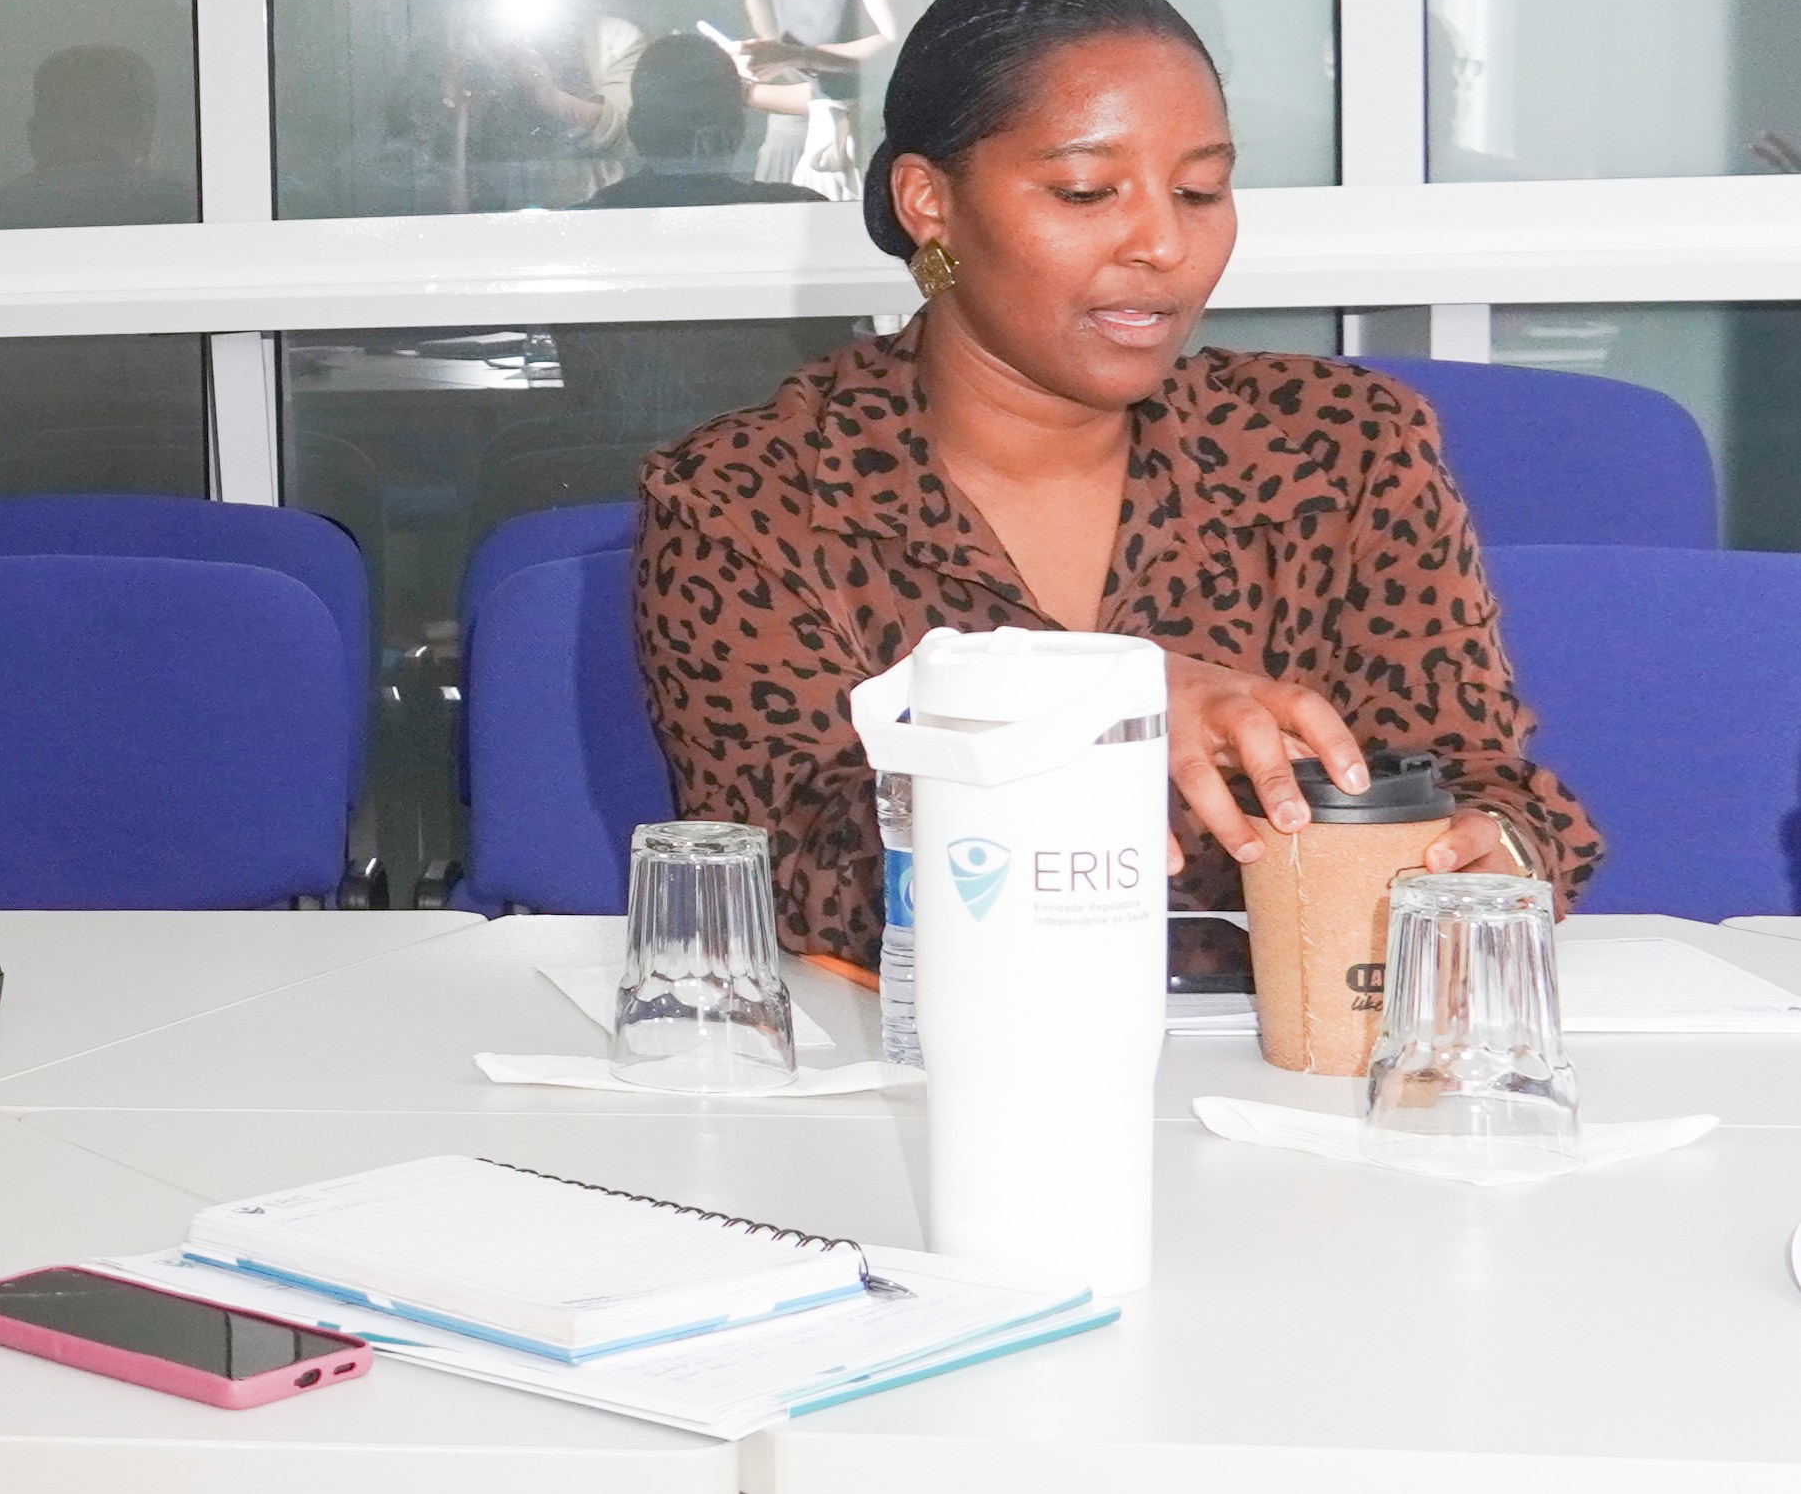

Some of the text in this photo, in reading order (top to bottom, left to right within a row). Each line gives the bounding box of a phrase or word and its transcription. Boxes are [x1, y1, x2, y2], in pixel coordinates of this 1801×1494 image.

[1034, 847, 1140, 892] ERIS
[1034, 901, 1084, 913] Entidade
[1034, 915, 1109, 927] Independente
